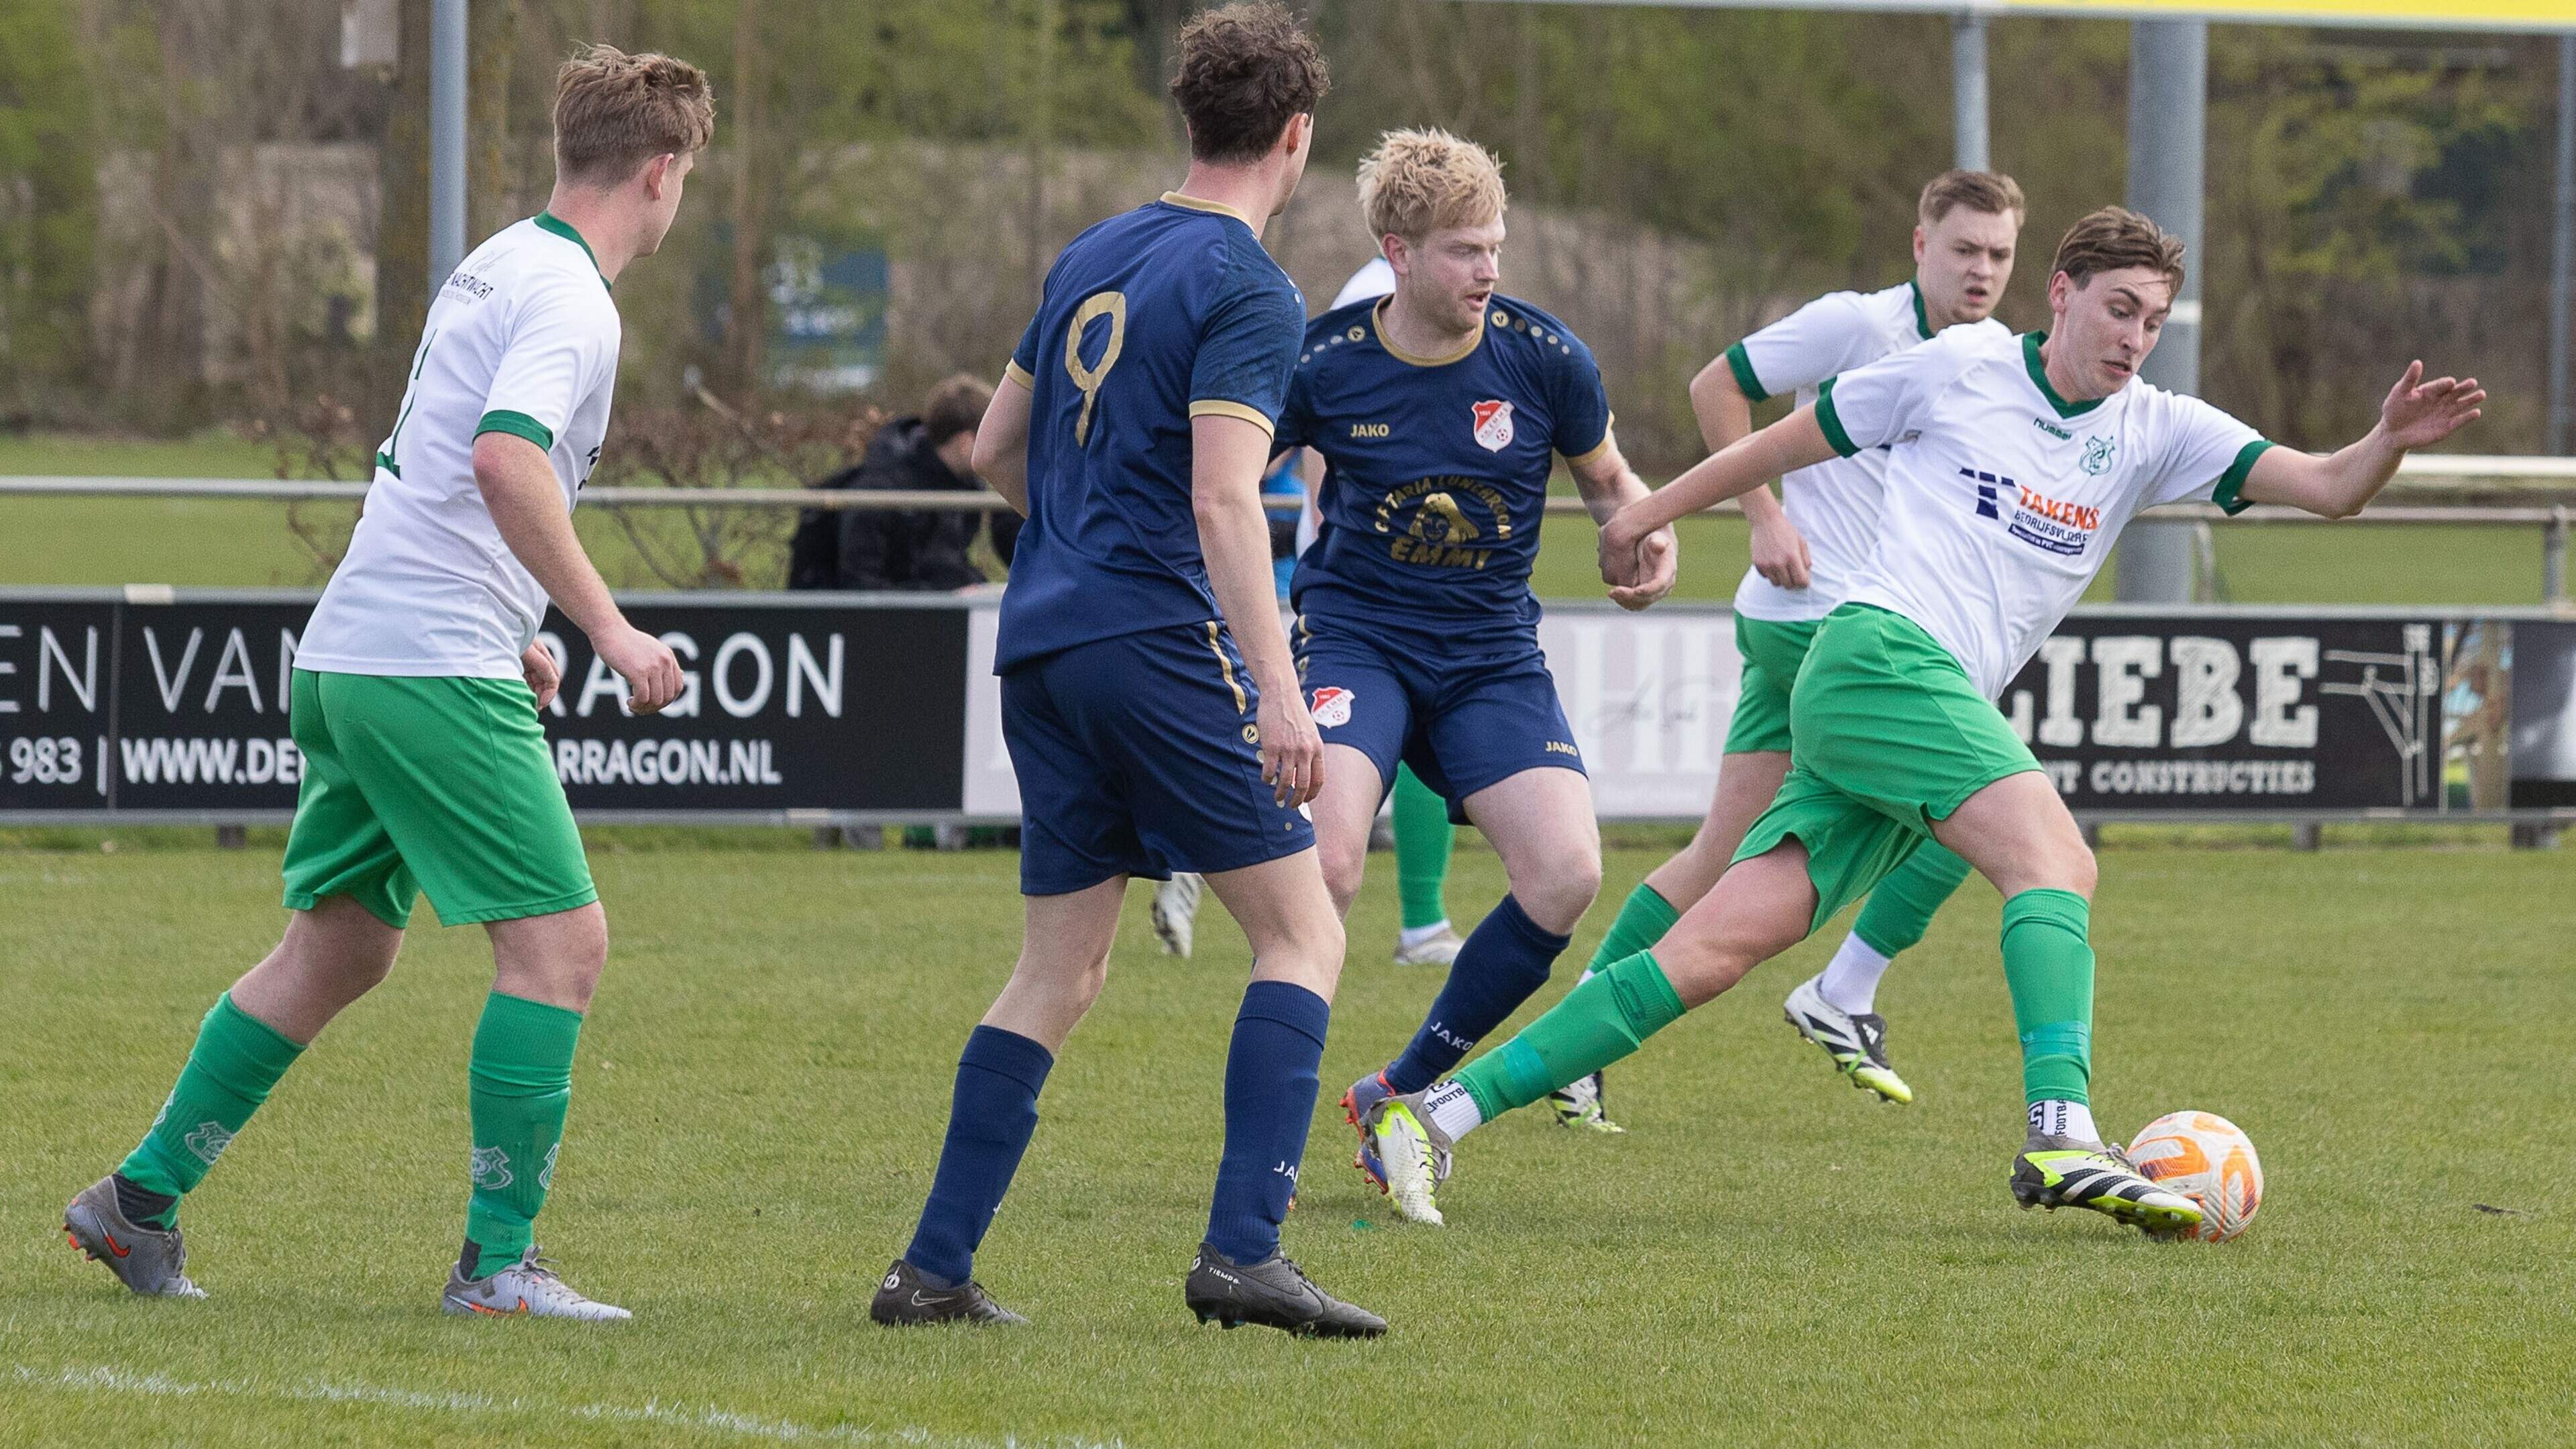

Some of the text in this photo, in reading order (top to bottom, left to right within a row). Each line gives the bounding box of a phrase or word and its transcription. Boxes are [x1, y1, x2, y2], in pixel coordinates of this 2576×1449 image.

[1065, 290, 1126, 449] 9
[1350, 423, 1390, 438] JAKO
[2019, 484, 2100, 530] TAKENS
[9, 737, 82, 784] 983
[1545, 741, 1578, 757] JAKO
[2090, 761, 2314, 795] CONSTRUCTIES
[1430, 1021, 1474, 1051] JAKO
[1208, 1267, 1239, 1285] TIEMPO
